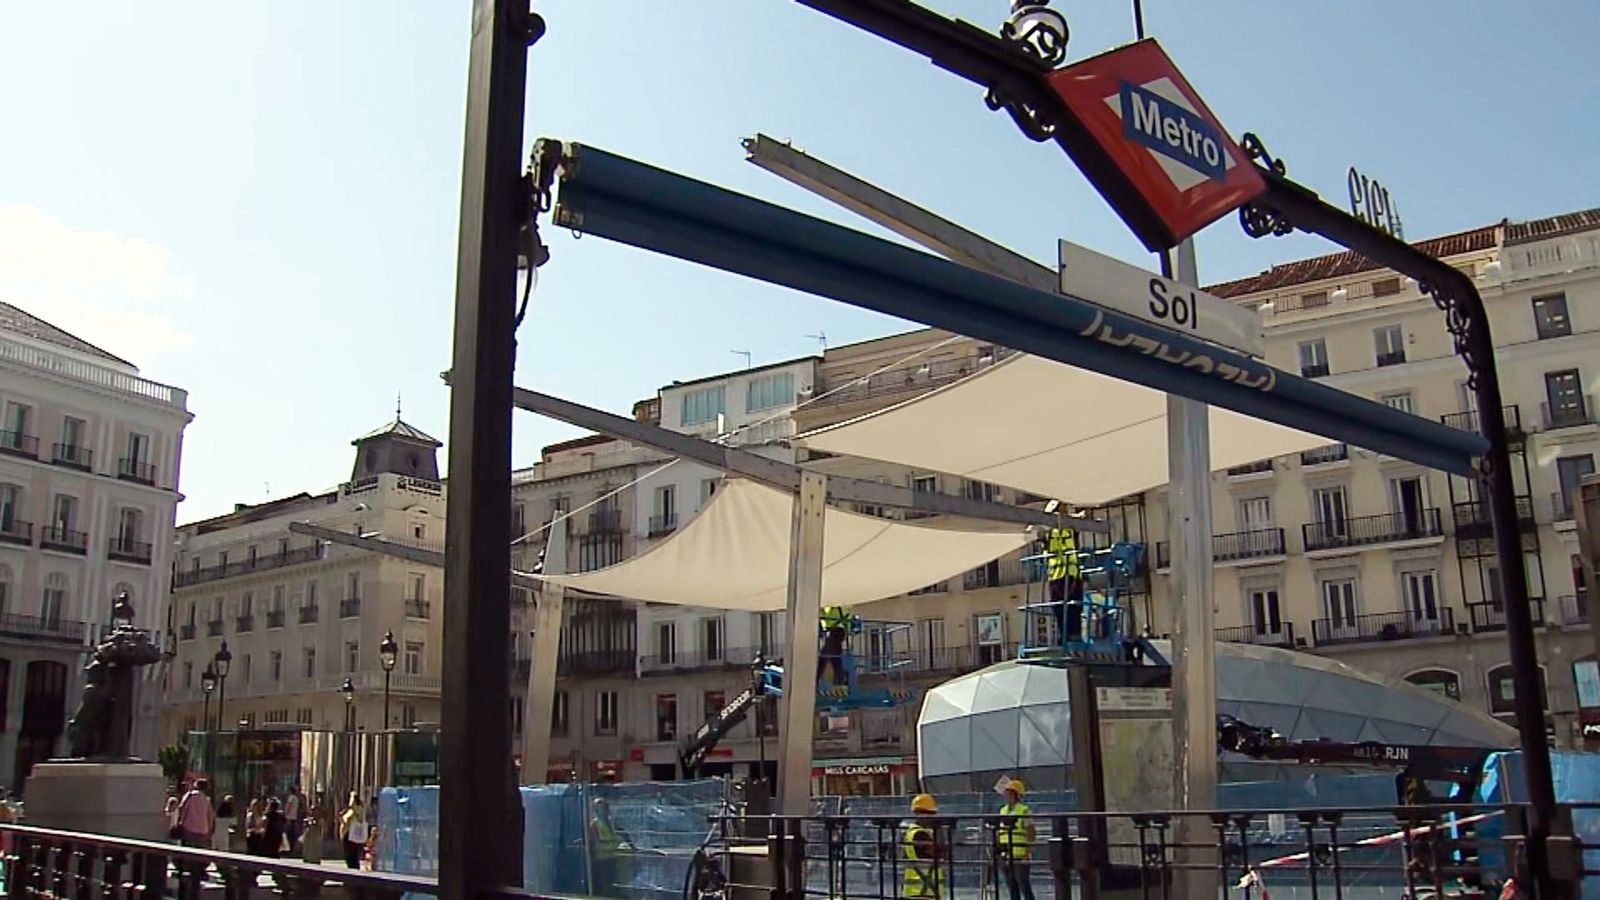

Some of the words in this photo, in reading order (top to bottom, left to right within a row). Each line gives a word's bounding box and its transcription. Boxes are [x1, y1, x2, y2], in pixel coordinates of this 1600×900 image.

[1131, 91, 1219, 166] Metro
[1150, 278, 1197, 329] Sol
[825, 766, 844, 775] MISS
